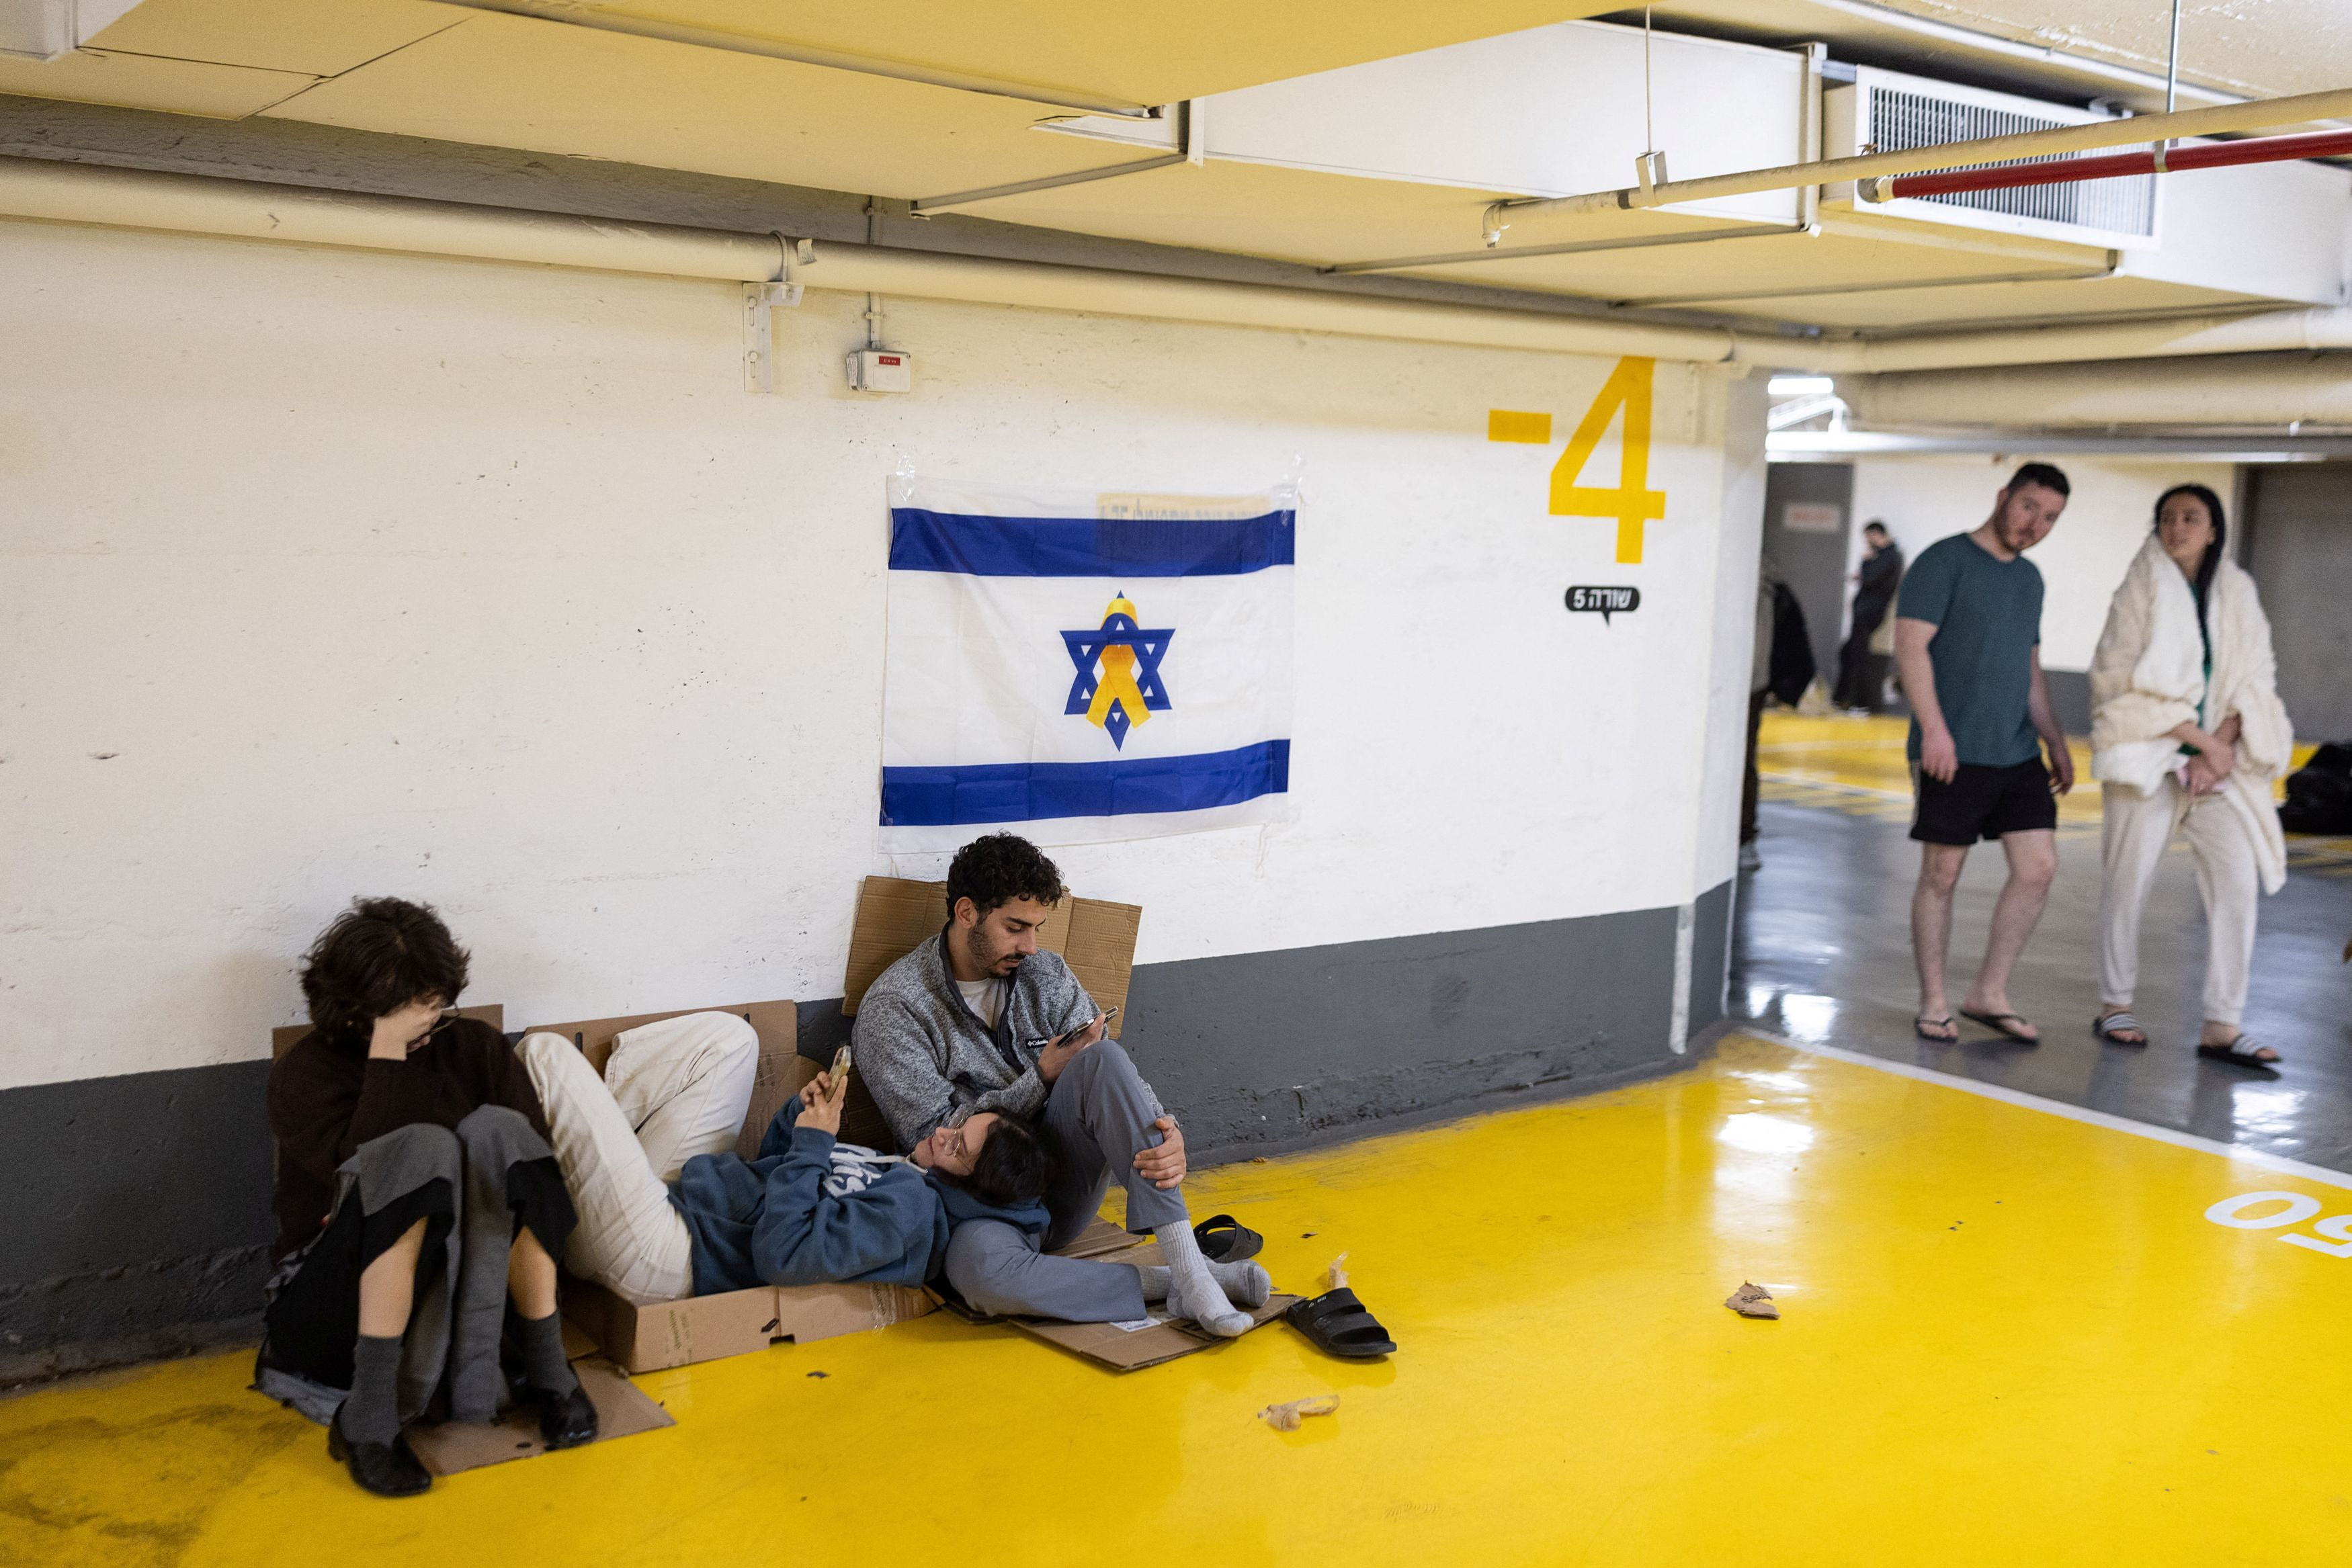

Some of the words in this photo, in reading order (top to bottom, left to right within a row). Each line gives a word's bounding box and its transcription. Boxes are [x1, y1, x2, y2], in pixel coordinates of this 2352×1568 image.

[1488, 355, 1666, 564] -4
[1573, 589, 1586, 609] 5
[1588, 589, 1632, 609] שורה
